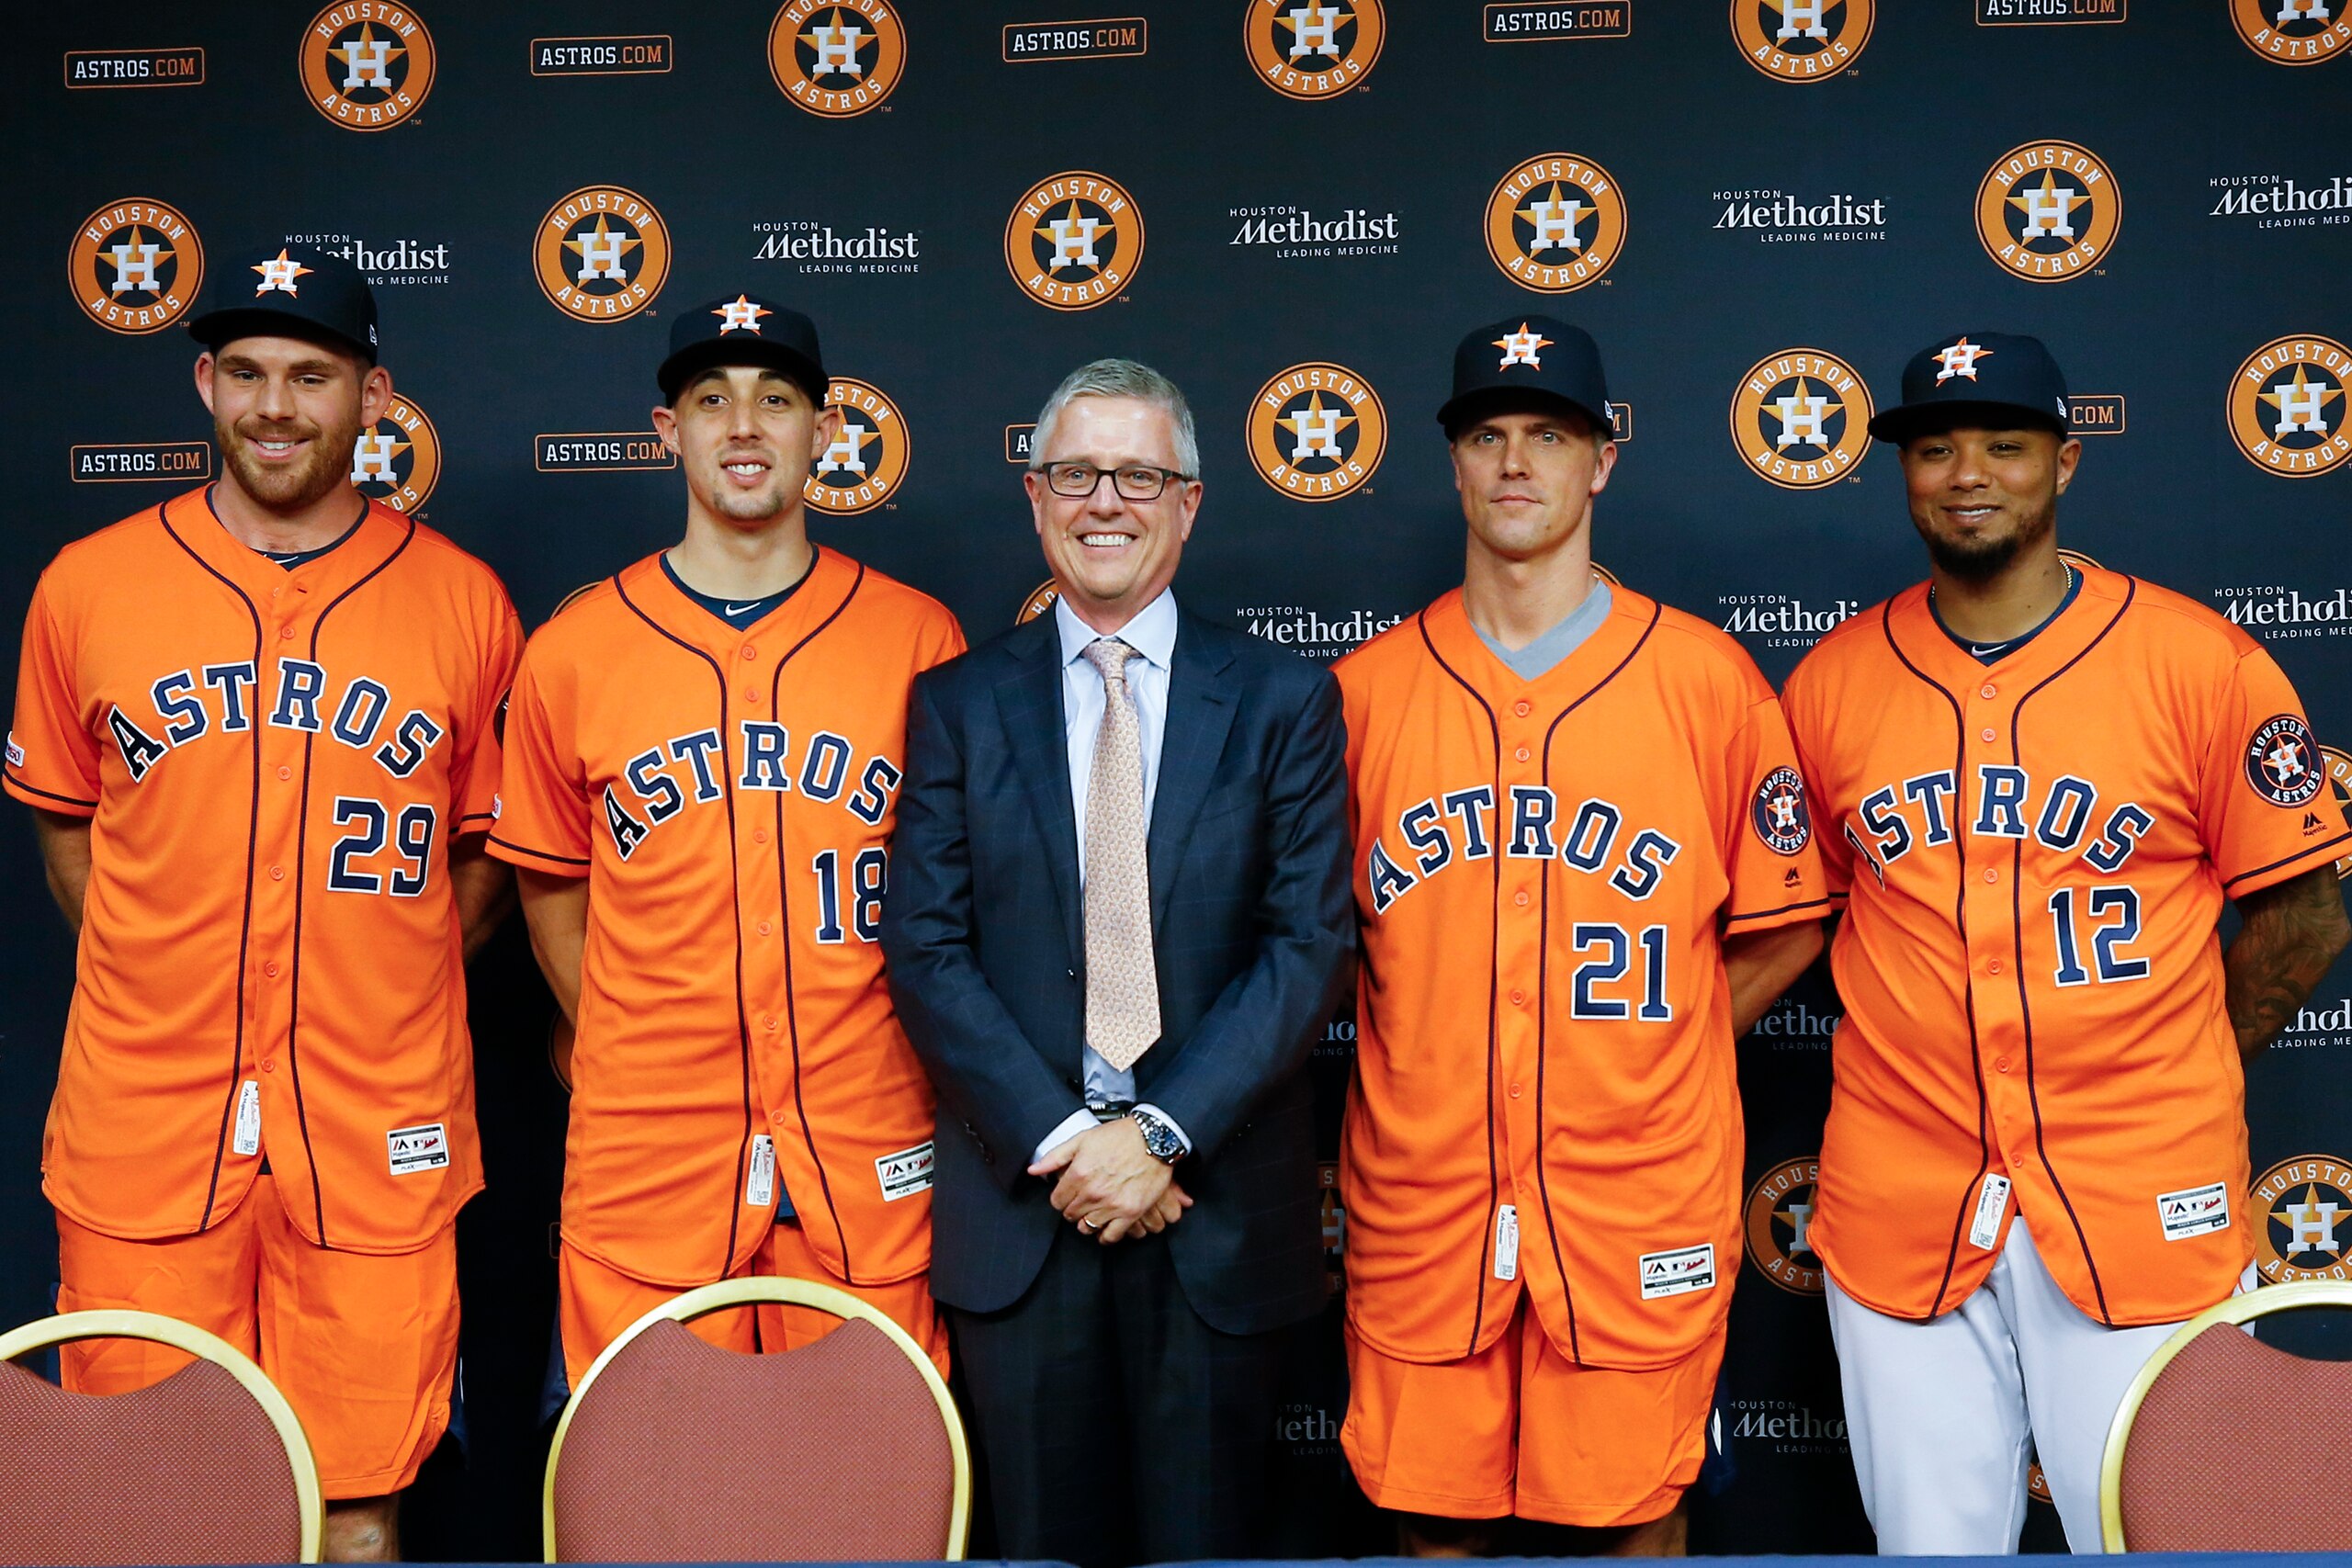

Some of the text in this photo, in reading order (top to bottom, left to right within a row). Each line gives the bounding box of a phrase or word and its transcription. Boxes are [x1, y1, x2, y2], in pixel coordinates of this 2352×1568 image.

[317, 2, 416, 39] HOUSTON
[786, 0, 888, 24] HOON
[1494, 10, 1621, 32] ASTROS.COM
[1012, 28, 1136, 52] ASTROS.COM
[1289, 7, 1340, 55] H
[2254, 22, 2351, 56] ASTROS
[343, 40, 391, 88] H
[540, 46, 662, 67] ASTROS.COM
[812, 27, 861, 73] H
[1755, 42, 1849, 74] ASTROS
[74, 58, 195, 78] ASTROS.COM
[1268, 59, 1360, 90] ASTROS
[322, 92, 412, 123] ASTROS
[791, 79, 882, 108] ASTROS
[1505, 162, 1609, 200] HOUSTON
[1996, 149, 2103, 186] HOUSTON
[2210, 175, 2279, 186] HOUSTON
[1023, 180, 1125, 218] HOUSTON
[1229, 206, 1295, 217] HOUSTON
[1713, 190, 1781, 200] HOUSTON
[1713, 195, 1886, 229] Methodist
[2209, 177, 2352, 215] Methodi
[86, 207, 186, 243] HOUSTON
[551, 194, 651, 231] HOUSTON
[753, 222, 819, 231] HOUSTON
[1229, 209, 1399, 246] Methodist
[1531, 199, 1581, 249] H
[2022, 188, 2075, 237] H
[2258, 217, 2315, 229] LEADING
[286, 234, 350, 243] HOUSTON
[753, 227, 919, 261] Methodist
[1050, 217, 1100, 266] H
[1276, 244, 1399, 258] LEADING MEDICINE
[1761, 231, 1886, 243] LEADING MEDICINE
[112, 244, 161, 291] H
[316, 240, 449, 270] thodist
[577, 231, 627, 279] H
[799, 264, 919, 274] LEADING MEDICINE
[1510, 252, 1602, 284] ASTROS
[2001, 242, 2097, 275] ASTROS
[256, 257, 301, 293] H
[390, 276, 449, 285] MEDICINE
[1028, 269, 1120, 301] ASTROS
[92, 295, 180, 326] ASTROS
[557, 283, 647, 314] ASTROS
[719, 299, 762, 331] H
[1499, 332, 1544, 366] H
[1936, 342, 1981, 380] H
[2246, 344, 2352, 383] HOUSTON
[1264, 371, 1367, 408] HOUSTON
[1749, 356, 1855, 394] HOUSTON
[824, 386, 890, 422] STON
[1776, 396, 1829, 446] H
[2274, 382, 2327, 433] H
[1291, 409, 1342, 458] H
[81, 453, 200, 472] ASTROS.COM
[350, 435, 397, 481] H
[545, 442, 667, 462] ASTROS.COM
[1756, 449, 1850, 481] ASTROS
[2253, 435, 2349, 468] ASTROS
[1270, 460, 1363, 492] ASTROS
[1719, 594, 1786, 604] HOUSTON
[2215, 586, 2284, 597] HOUSTON
[2223, 589, 2352, 625] Method
[1237, 607, 1303, 616] HOUSTON
[1723, 601, 1858, 632] Methodi
[2265, 627, 2322, 639] LEADING
[1292, 649, 1339, 659] ADING
[107, 657, 444, 783] ASTROS
[2251, 720, 2305, 758] HOUSTON
[2269, 742, 2304, 782] H
[605, 720, 903, 862] ASTROS
[2272, 770, 2321, 802] ASTROS
[326, 795, 436, 897] 29
[1368, 784, 1681, 915] ASTROS
[1767, 826, 1807, 851] ASTROS
[812, 846, 888, 944] 18
[2048, 885, 2150, 987] 12
[1570, 922, 1672, 1021] 21
[1762, 1166, 1818, 1201] HOUS
[2258, 1164, 2352, 1202] HOUSTO
[2286, 1202, 2339, 1251] H
[1768, 1258, 1825, 1286] AST
[1734, 1407, 1848, 1439] Metho
